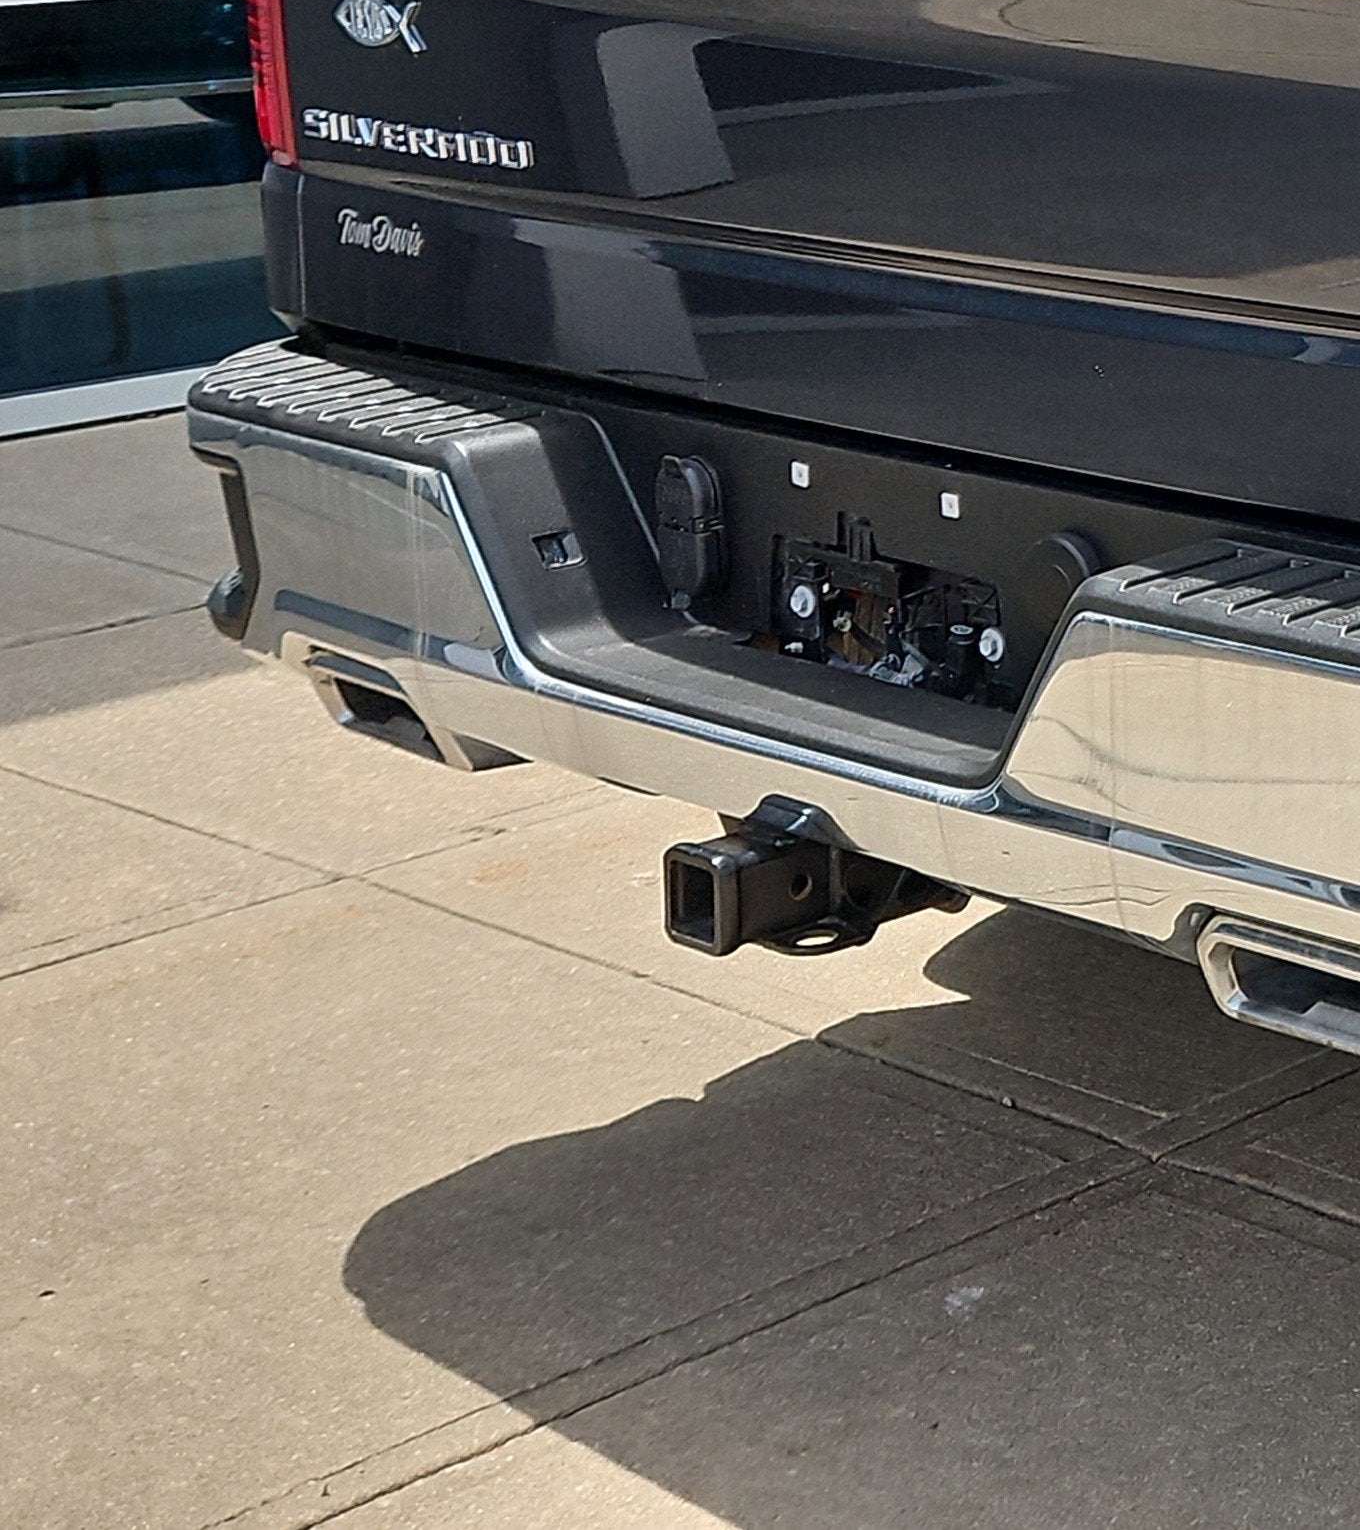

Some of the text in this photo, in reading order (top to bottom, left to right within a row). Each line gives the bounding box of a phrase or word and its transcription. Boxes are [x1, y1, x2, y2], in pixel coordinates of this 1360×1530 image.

[302, 107, 535, 170] SILVERADO
[337, 208, 426, 257] Tom Davis
